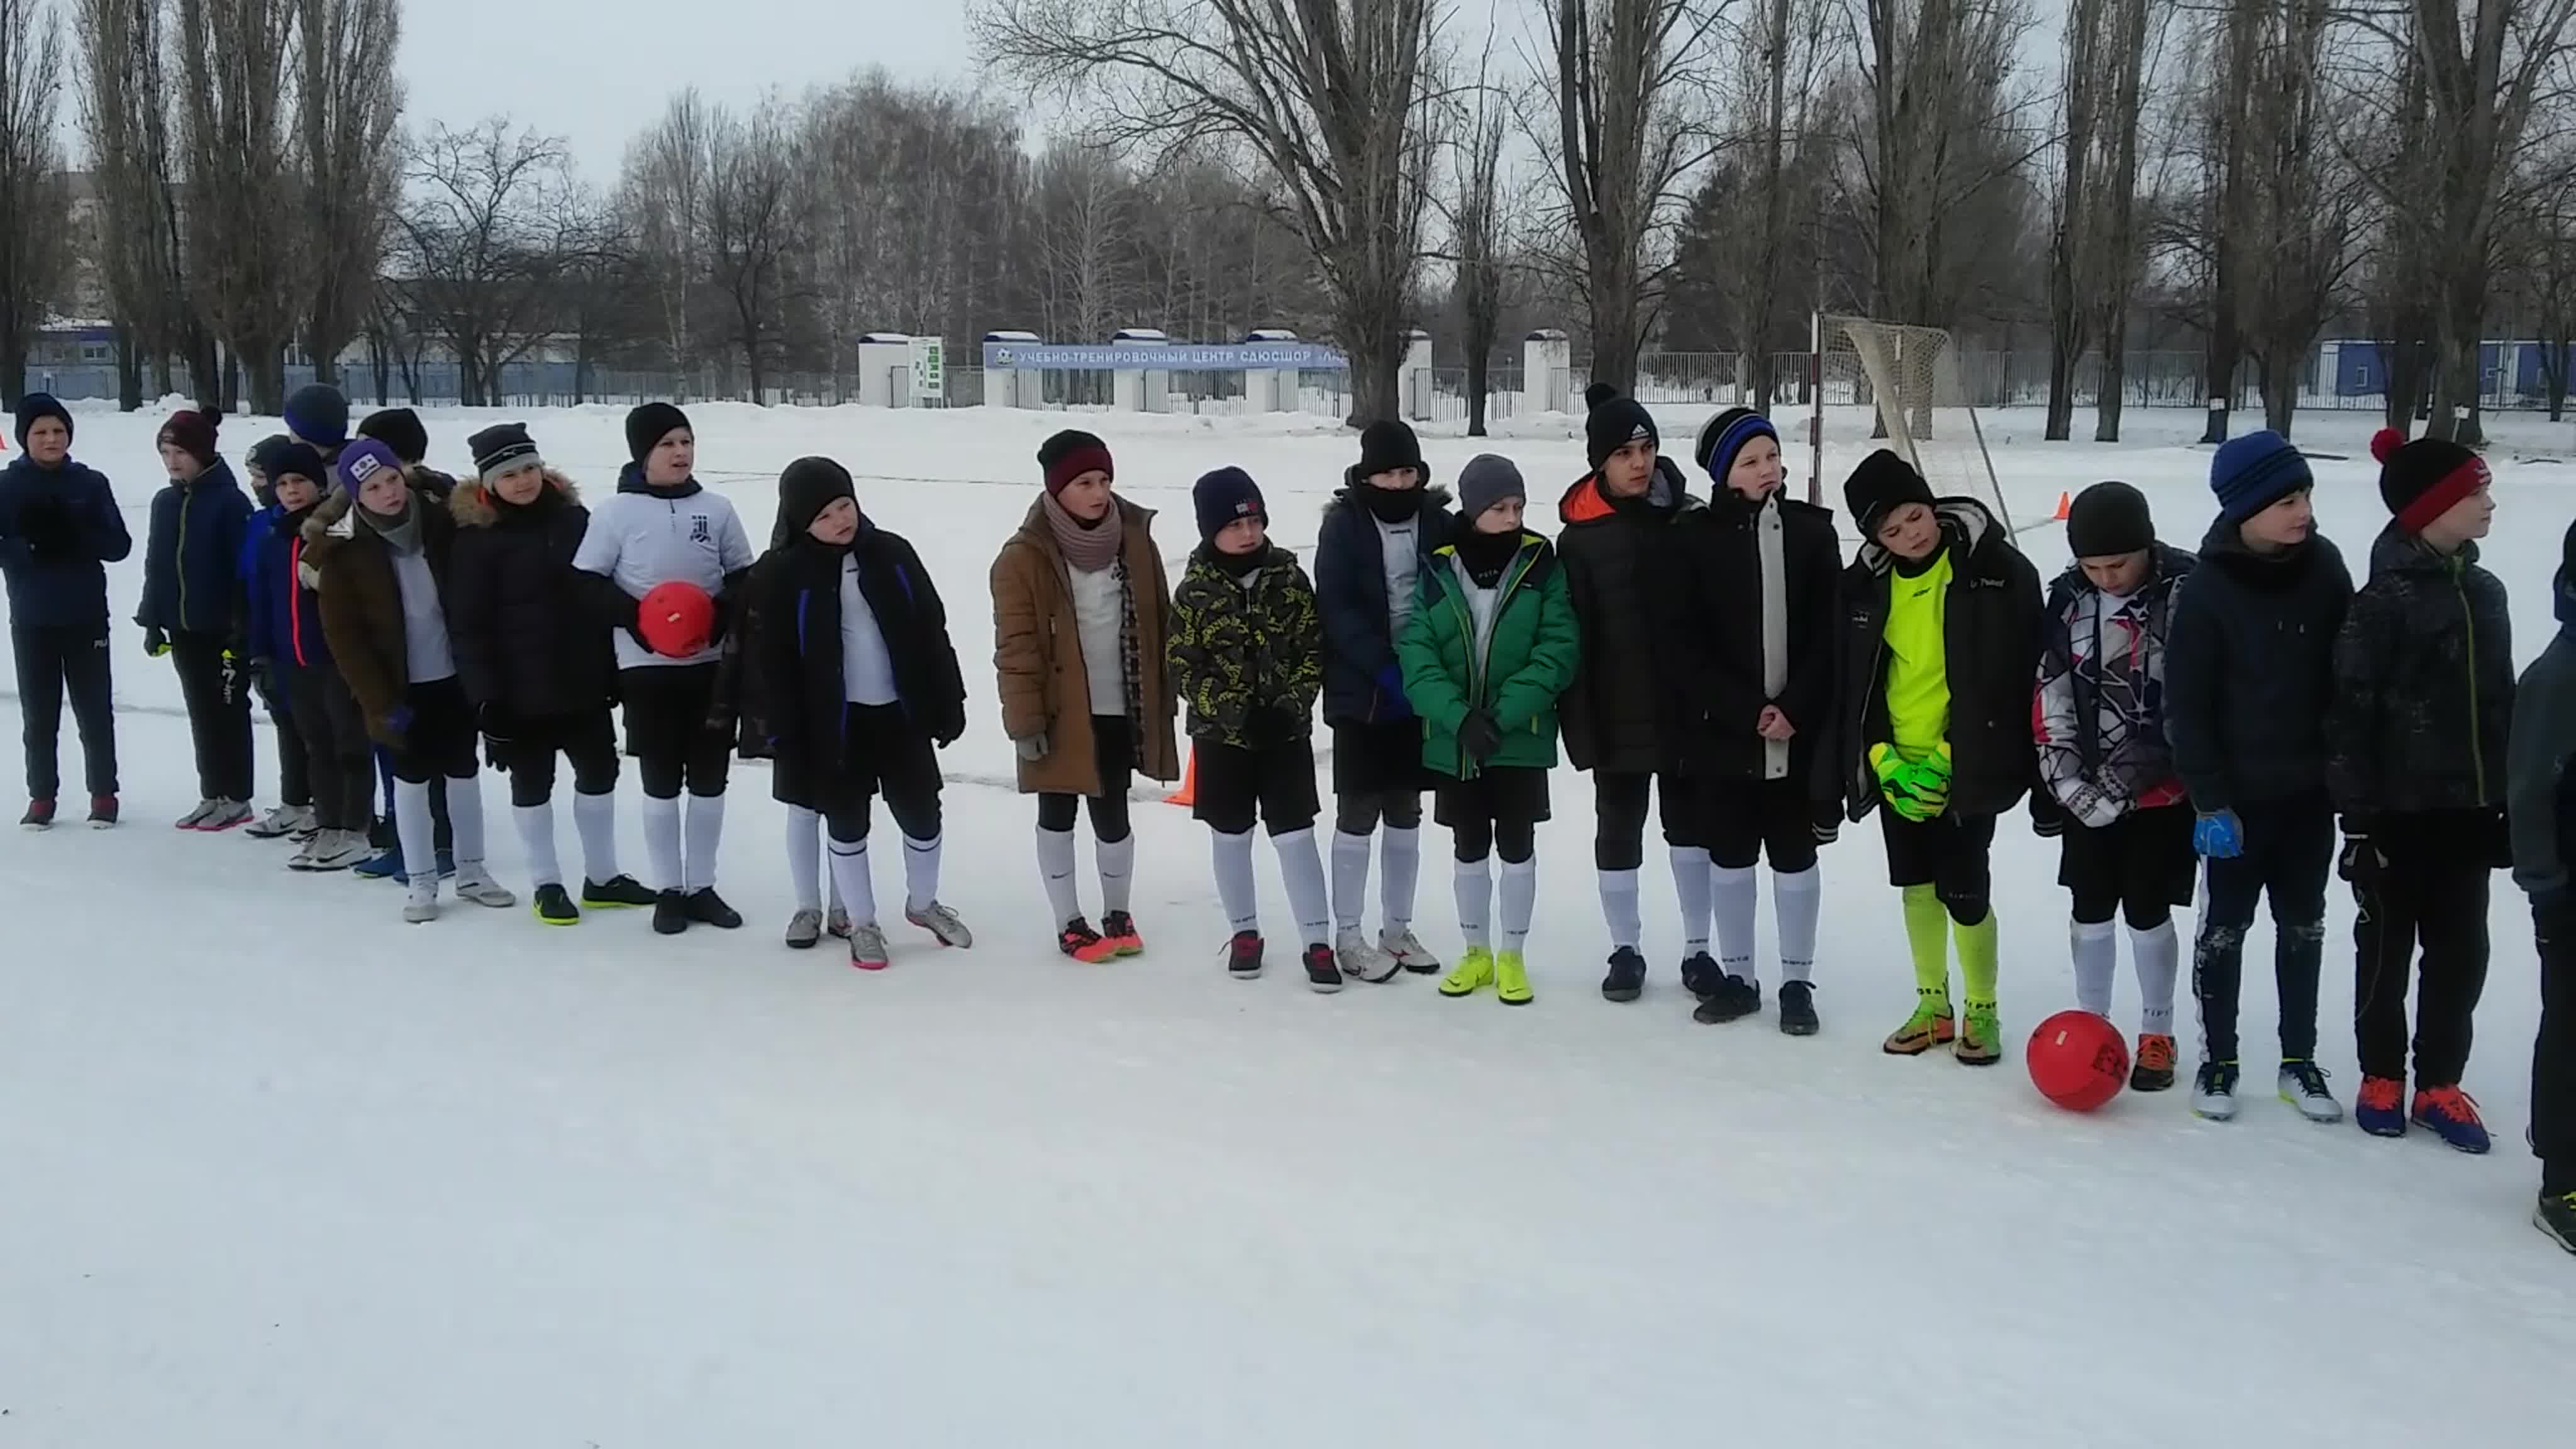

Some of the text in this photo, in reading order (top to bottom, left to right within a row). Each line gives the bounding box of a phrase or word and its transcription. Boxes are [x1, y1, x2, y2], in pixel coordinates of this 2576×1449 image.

[1019, 351, 1188, 363] УЧЕБНО-ТРЕНИРОВОЧНЫЙ
[1192, 352, 1234, 363] ЦЕНТР
[1240, 351, 1311, 363] СДЮСШОР
